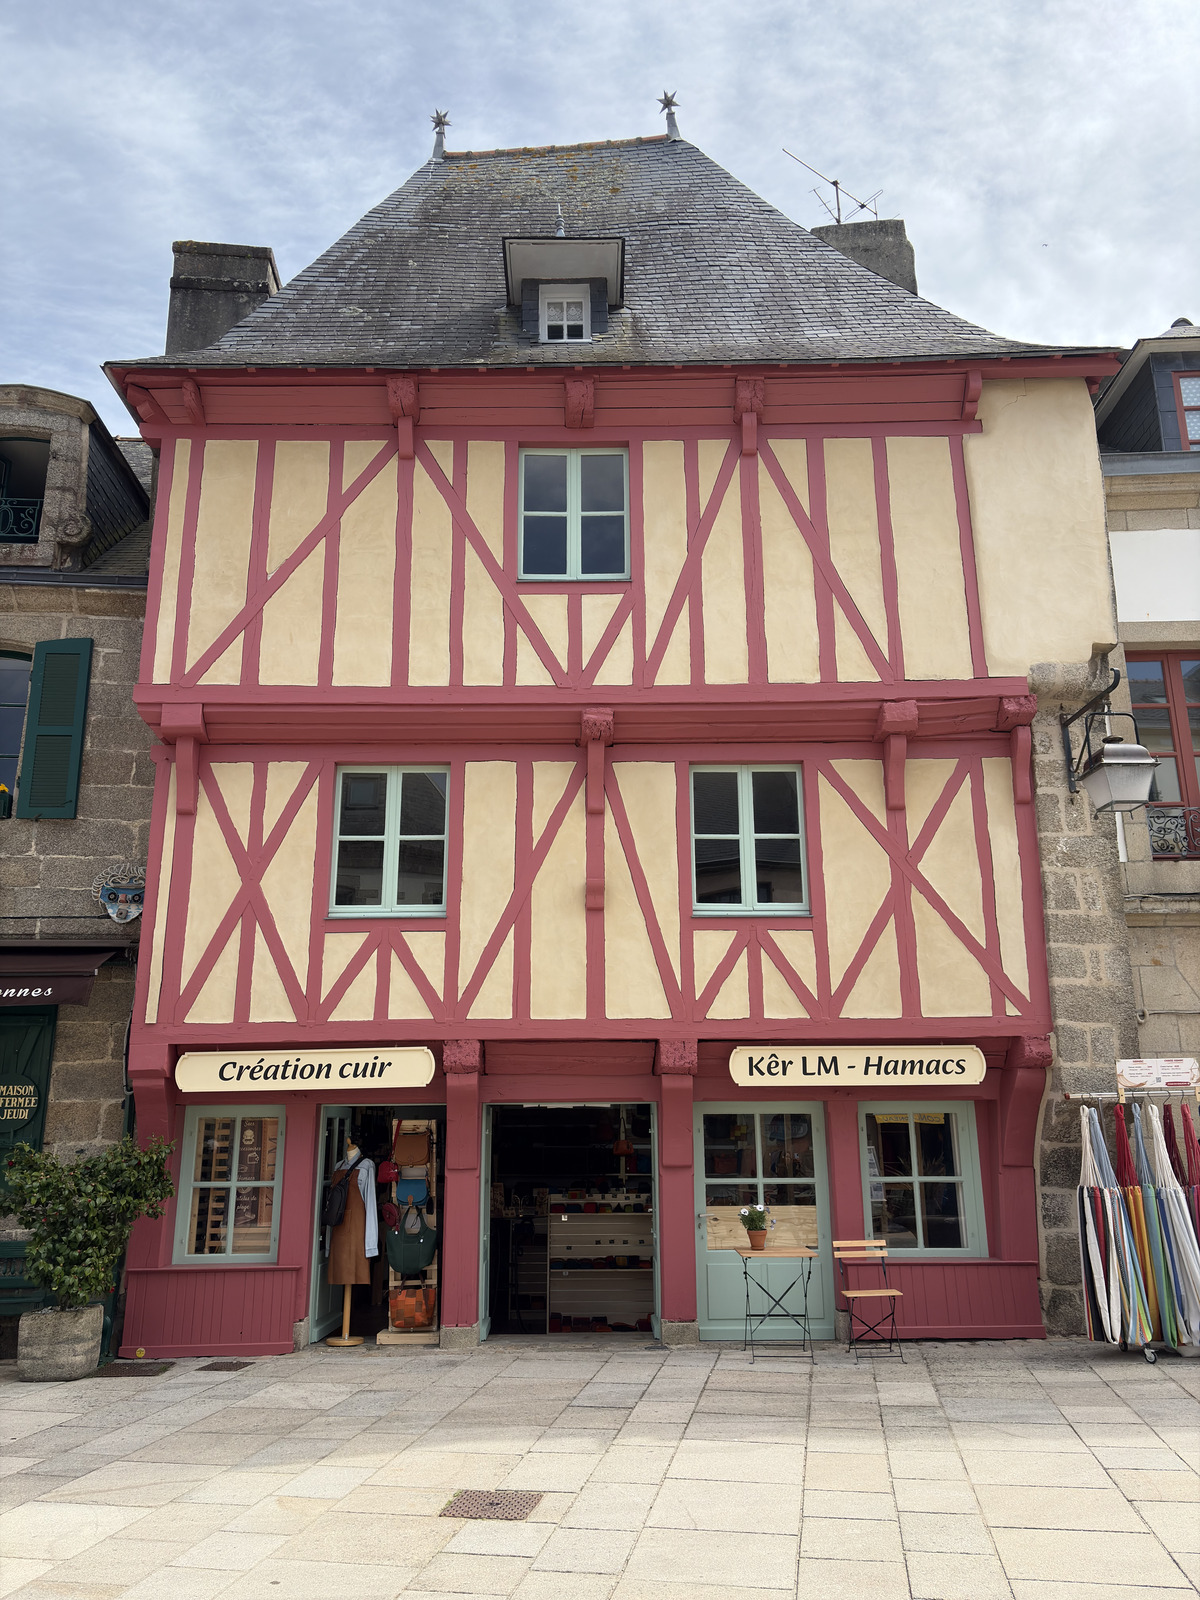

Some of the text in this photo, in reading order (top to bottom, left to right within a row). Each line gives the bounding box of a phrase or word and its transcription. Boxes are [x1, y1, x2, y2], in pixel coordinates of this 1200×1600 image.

[0, 987, 53, 998] nnes
[218, 1055, 393, 1081] Création cuir
[748, 1053, 794, 1076] Kêr
[801, 1055, 840, 1076] LM
[863, 1055, 967, 1076] Hamacs
[0, 1085, 35, 1096] MAISON
[0, 1109, 30, 1120] JEUDI
